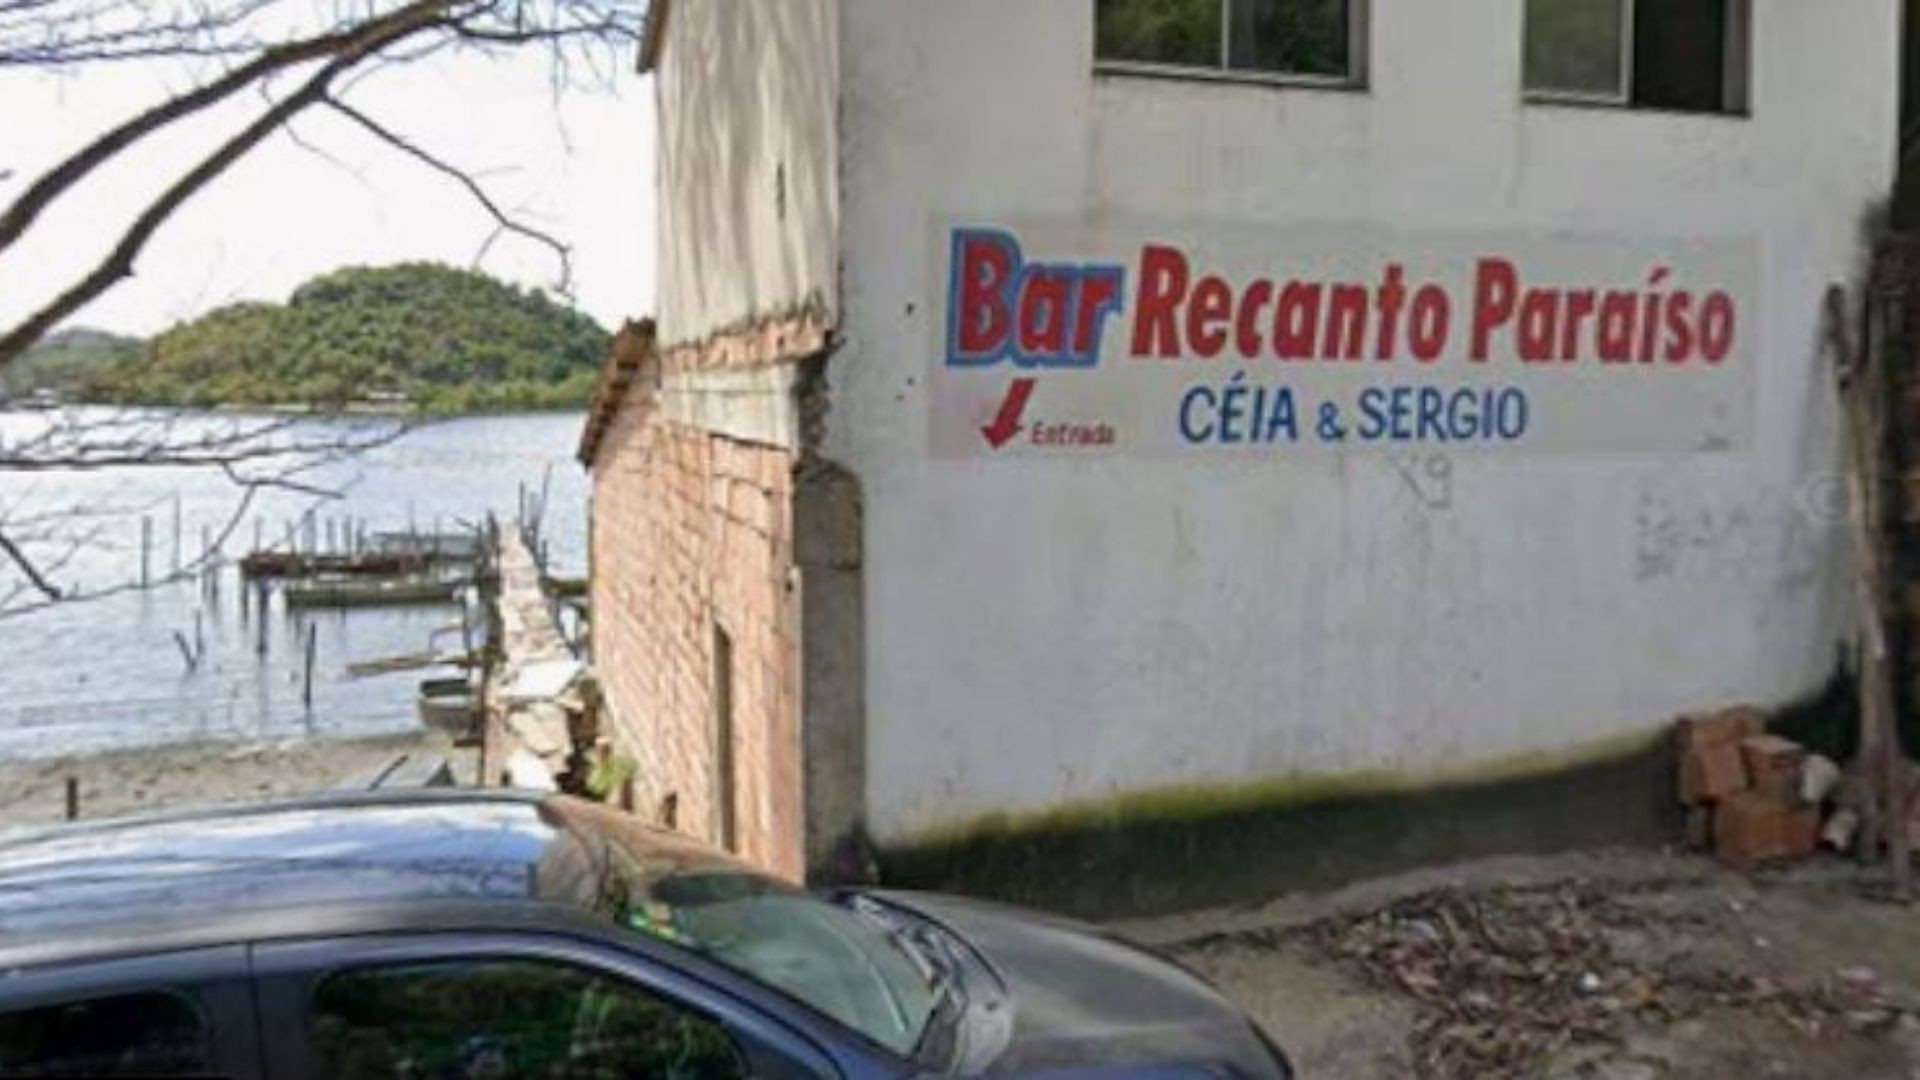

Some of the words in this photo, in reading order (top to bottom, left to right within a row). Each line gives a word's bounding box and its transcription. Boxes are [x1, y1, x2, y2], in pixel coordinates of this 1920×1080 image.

[945, 227, 1125, 367] Bar
[1131, 244, 1450, 362] Recanto
[1469, 257, 1736, 363] Paraíso
[1179, 371, 1297, 444] CÉIA
[1314, 402, 1346, 441] &
[1358, 386, 1529, 441] SERGIO
